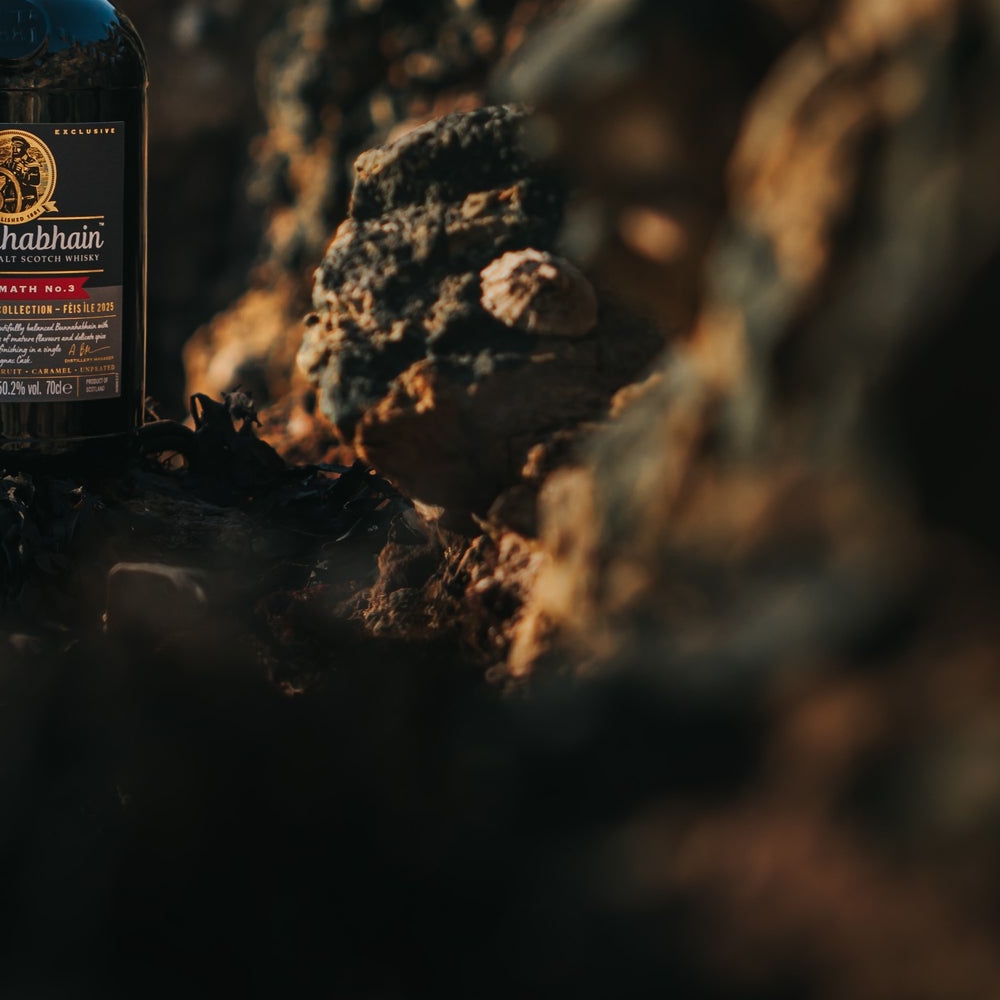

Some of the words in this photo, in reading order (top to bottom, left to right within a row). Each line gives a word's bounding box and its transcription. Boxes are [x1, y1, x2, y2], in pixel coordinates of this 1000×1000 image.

[54, 127, 116, 136] EXCLUSIVE
[20, 254, 61, 263] SCOTCH
[65, 253, 100, 262] WHISKY
[45, 283, 75, 293] No.3
[97, 302, 114, 313] 2025
[27, 323, 54, 331] balanced
[98, 320, 109, 329] with
[3, 334, 11, 343] of
[35, 334, 60, 343] flavours
[61, 333, 74, 341] and
[74, 332, 94, 341] delicate
[0, 344, 28, 357] finishing
[43, 345, 61, 356] single
[80, 364, 115, 373] UNPEATED
[27, 381, 42, 395] vol.
